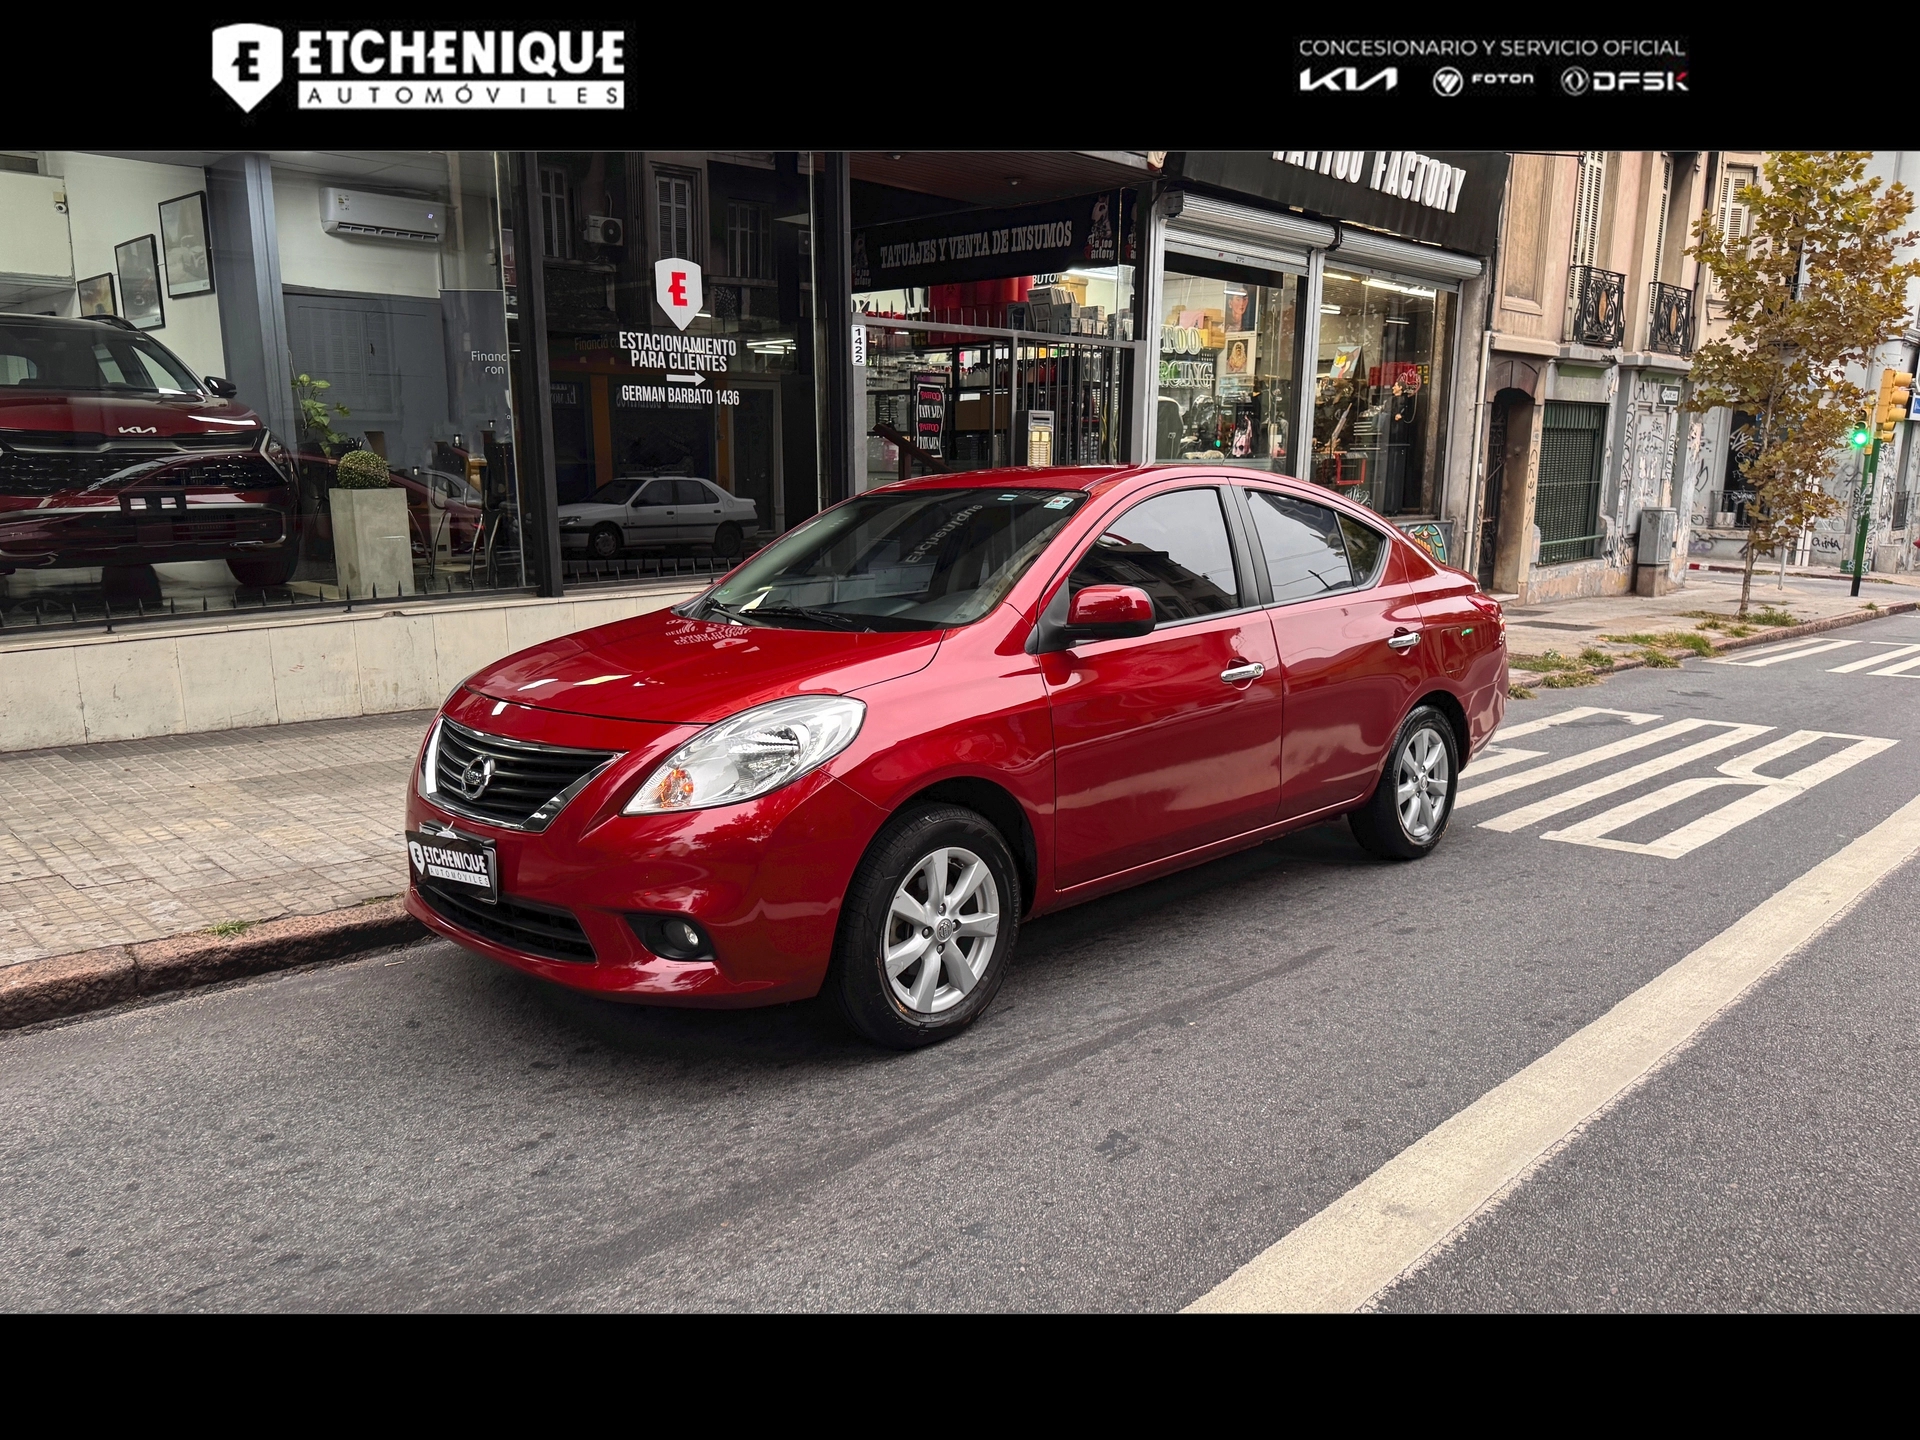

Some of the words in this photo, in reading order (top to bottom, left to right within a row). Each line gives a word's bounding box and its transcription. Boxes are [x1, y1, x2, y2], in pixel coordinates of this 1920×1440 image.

[1369, 151, 1467, 214] FACTORY
[880, 239, 937, 269] TATUAJES
[936, 237, 948, 261] Y
[948, 232, 990, 260] VENTA
[992, 229, 1009, 255] DE
[1011, 220, 1073, 253] INSUMOS
[619, 331, 737, 357] ESTACIONAMIENTO
[854, 328, 863, 364] 1422
[630, 350, 667, 369] PARA
[668, 353, 728, 372] CLIENTES
[621, 384, 666, 403] GERMAN
[667, 386, 713, 405] BARBATO
[715, 389, 740, 406] 1436
[422, 845, 488, 873] ETCHENIQUE
